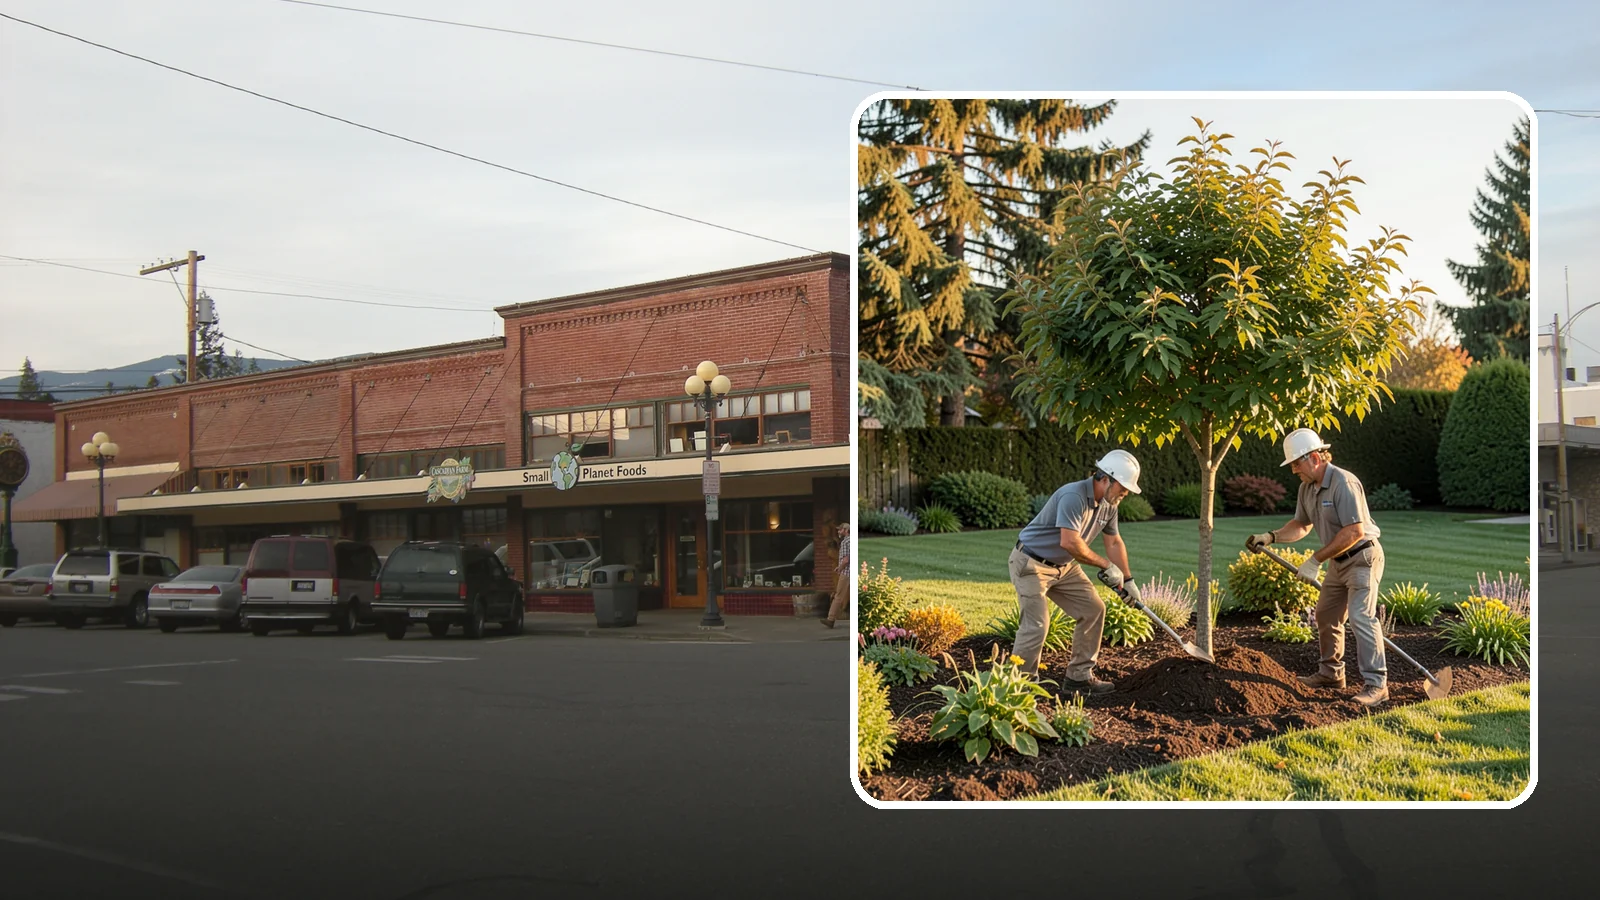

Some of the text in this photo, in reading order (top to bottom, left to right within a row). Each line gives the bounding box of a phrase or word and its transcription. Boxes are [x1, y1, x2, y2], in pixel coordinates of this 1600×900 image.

[523, 464, 647, 483] Small Planet Foods
